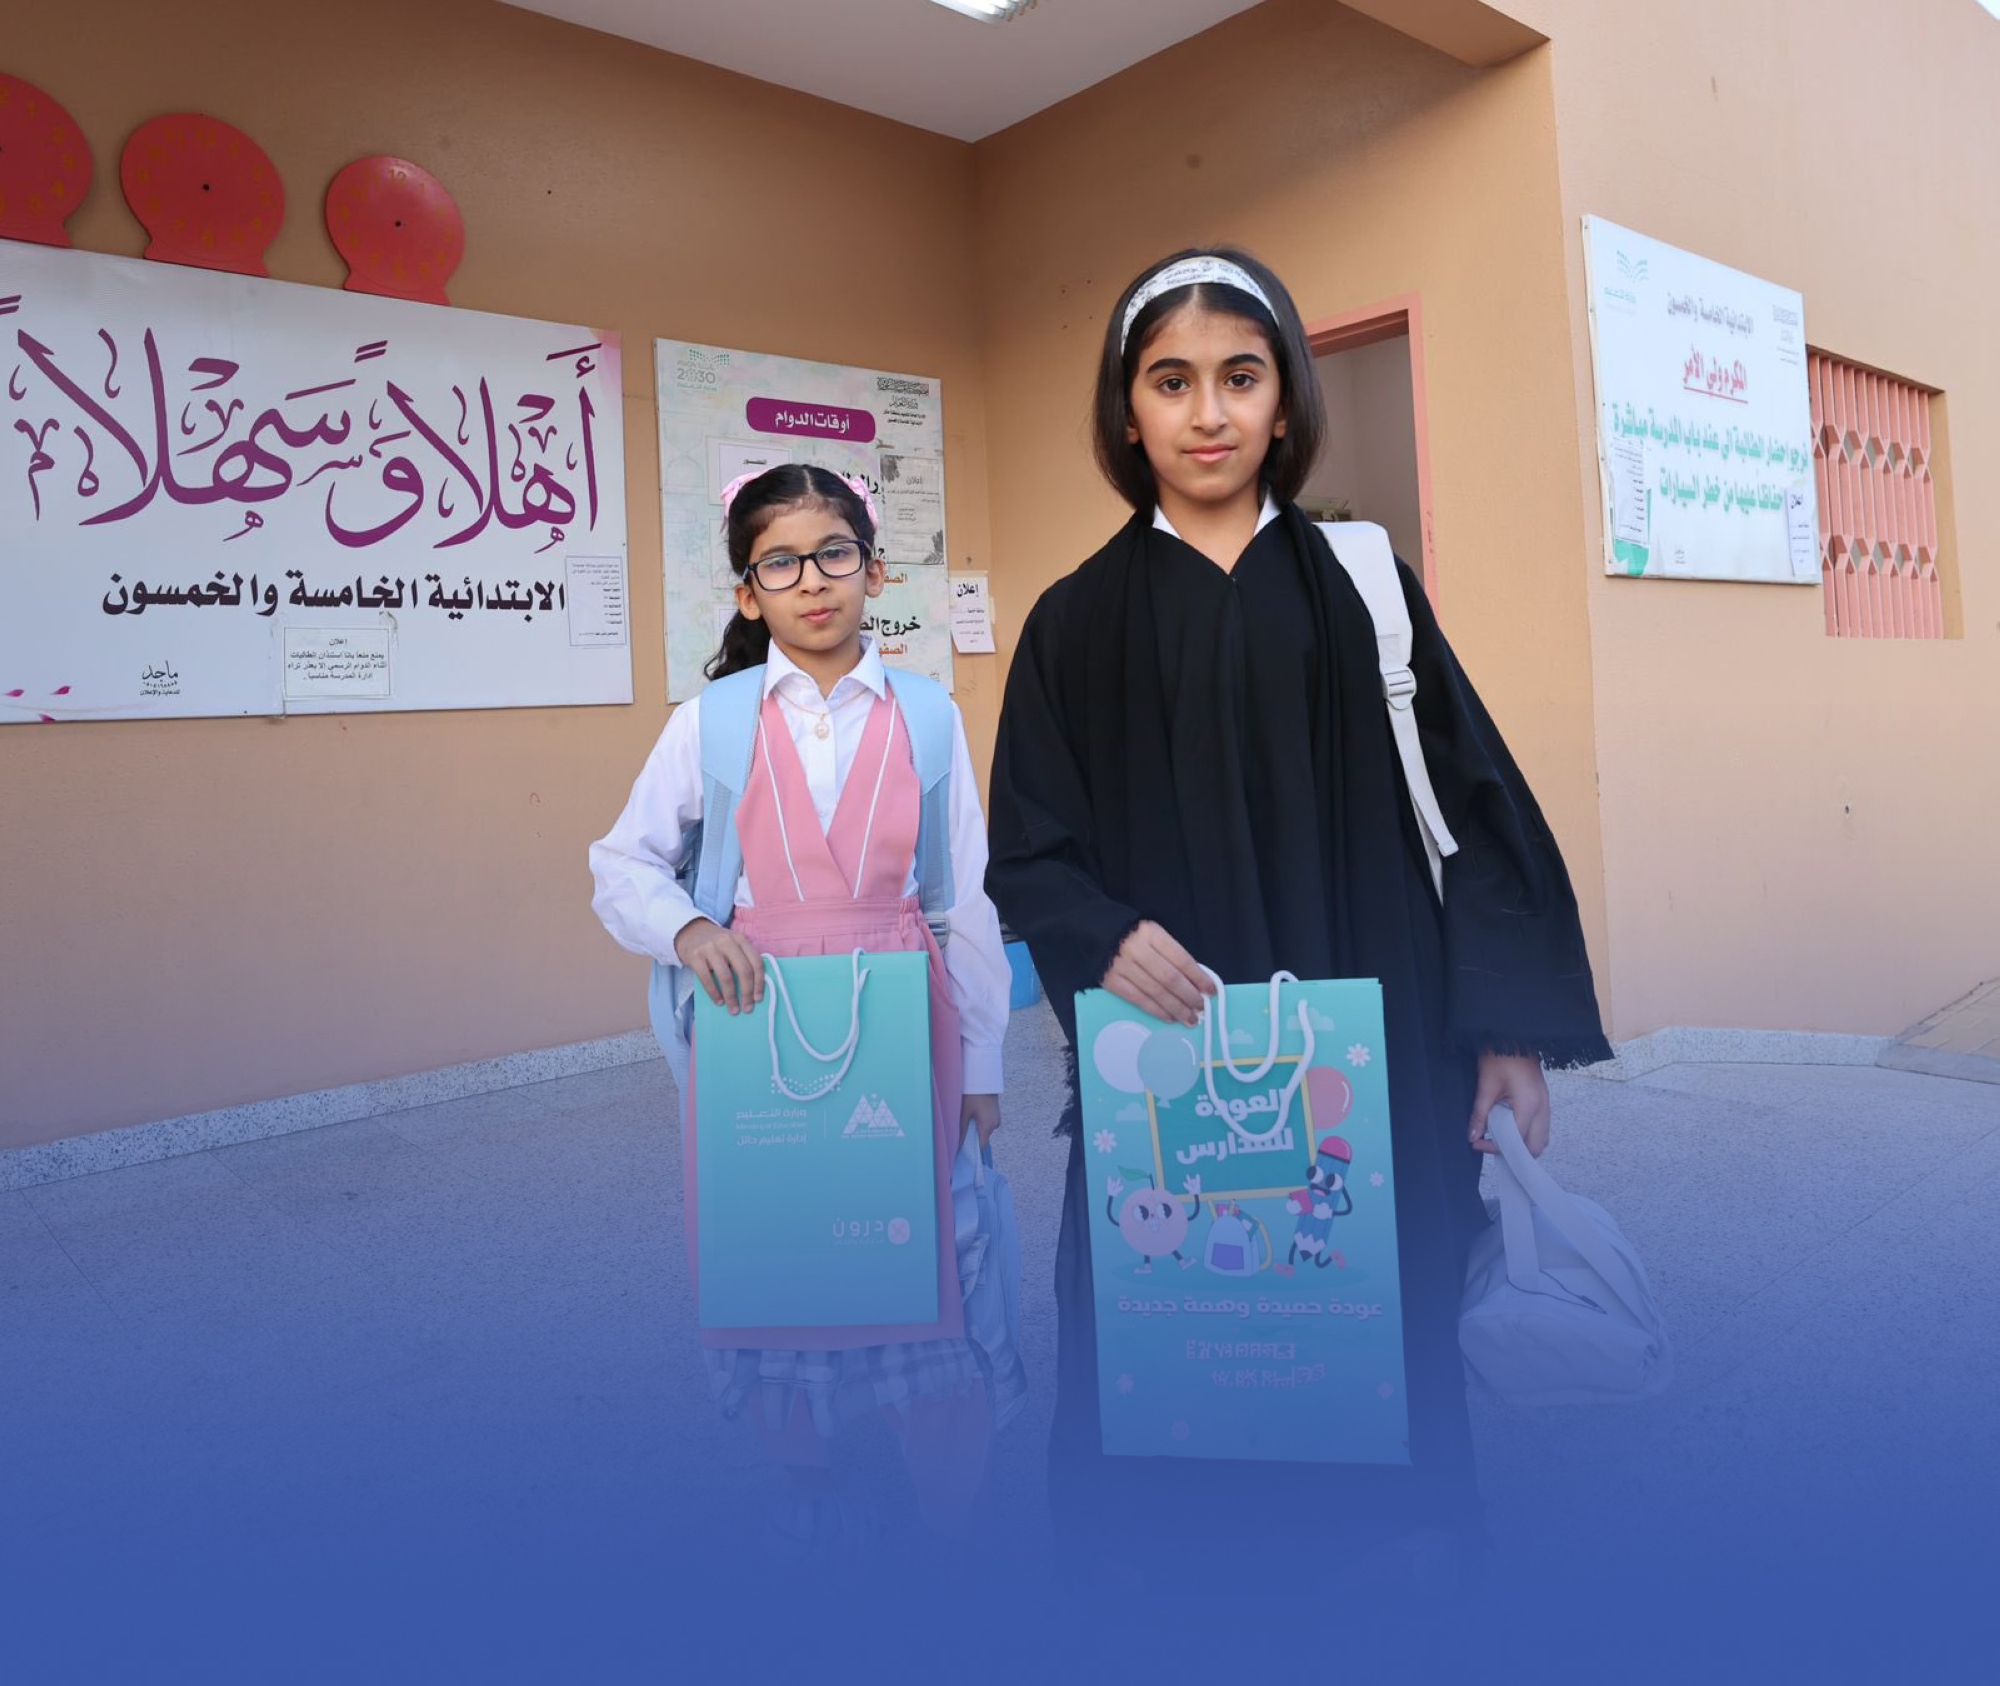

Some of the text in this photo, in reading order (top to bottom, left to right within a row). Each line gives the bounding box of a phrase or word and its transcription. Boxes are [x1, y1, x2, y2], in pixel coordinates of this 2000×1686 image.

[775, 410, 850, 434] أوقات الدوام
[102, 570, 279, 617] والخمسون
[285, 569, 417, 609] الخامسة
[428, 574, 566, 622] الابتدائية
[881, 616, 921, 637] خروج
[1118, 1294, 1384, 1321] عودة حميدة وهمة جديدة
